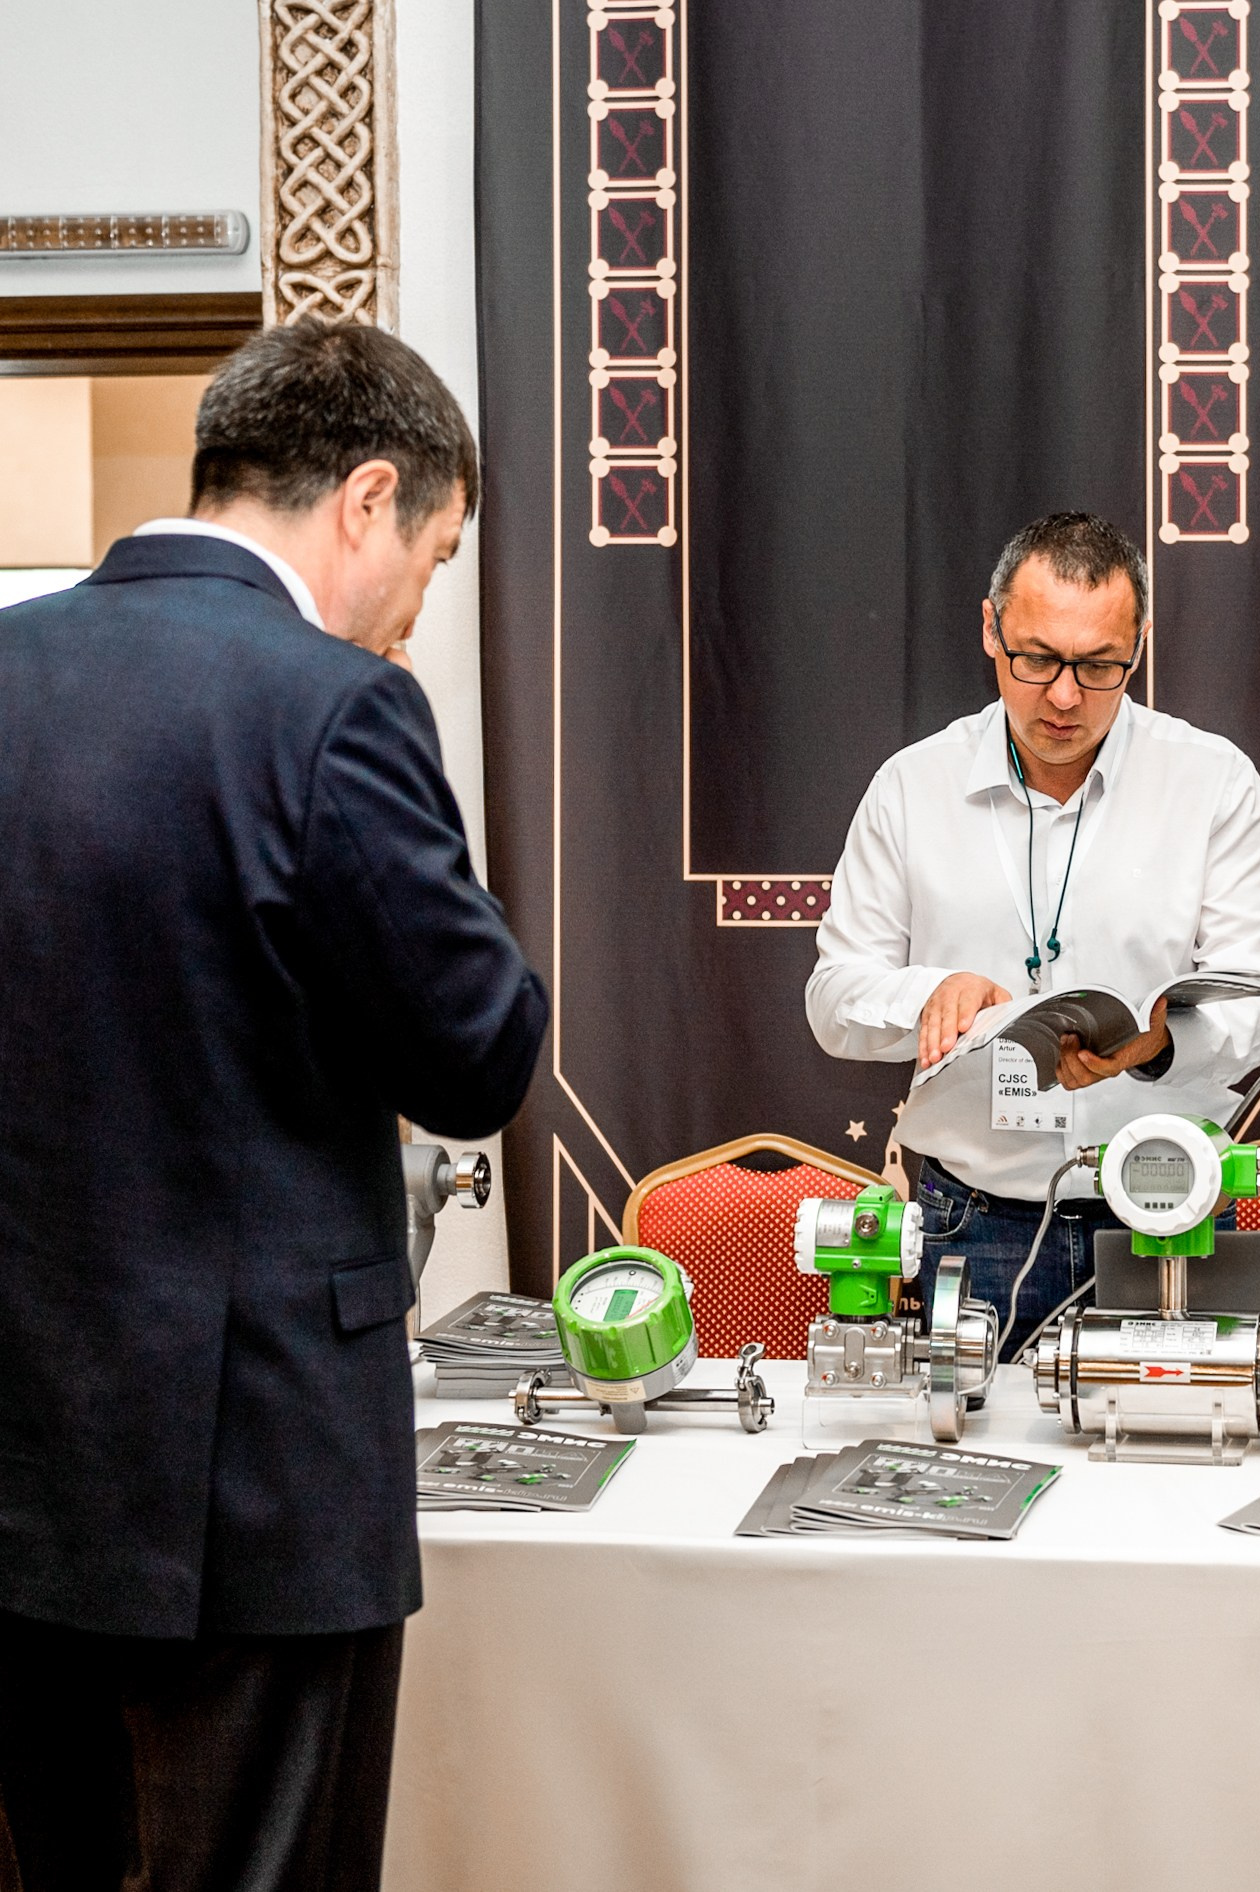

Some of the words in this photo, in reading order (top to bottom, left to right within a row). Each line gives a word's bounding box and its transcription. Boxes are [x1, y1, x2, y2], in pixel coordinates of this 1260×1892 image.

[998, 1074, 1028, 1083] CJSC
[998, 1087, 1037, 1097] «EMIS»
[517, 1431, 608, 1448] ЭМИС
[939, 1452, 1033, 1471] ЭМИС
